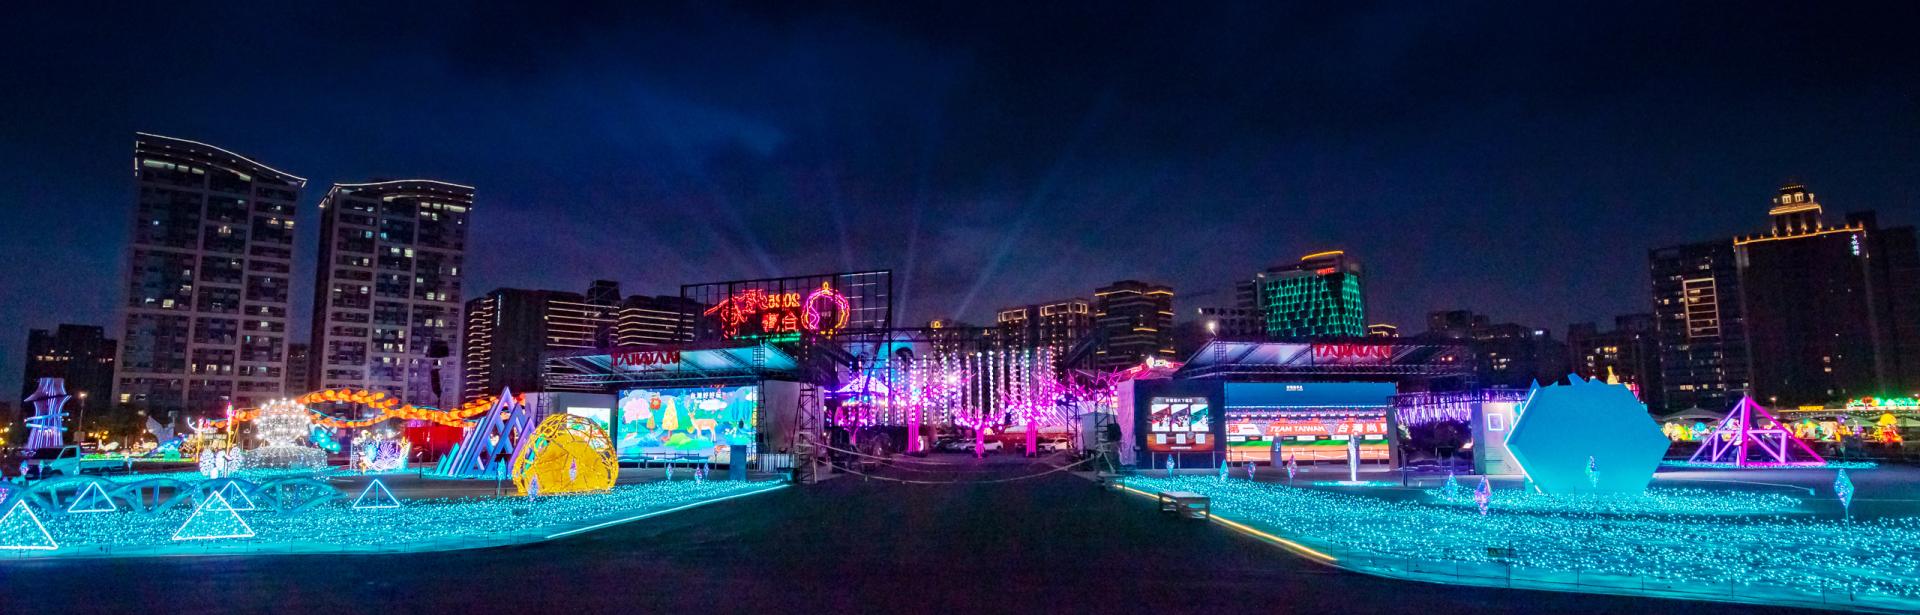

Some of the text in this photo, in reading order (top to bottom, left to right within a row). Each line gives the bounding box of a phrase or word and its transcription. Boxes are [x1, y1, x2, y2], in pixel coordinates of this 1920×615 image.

[1313, 343, 1393, 358] TAIWAN
[1270, 425, 1326, 433] TEAM TAIWAN
